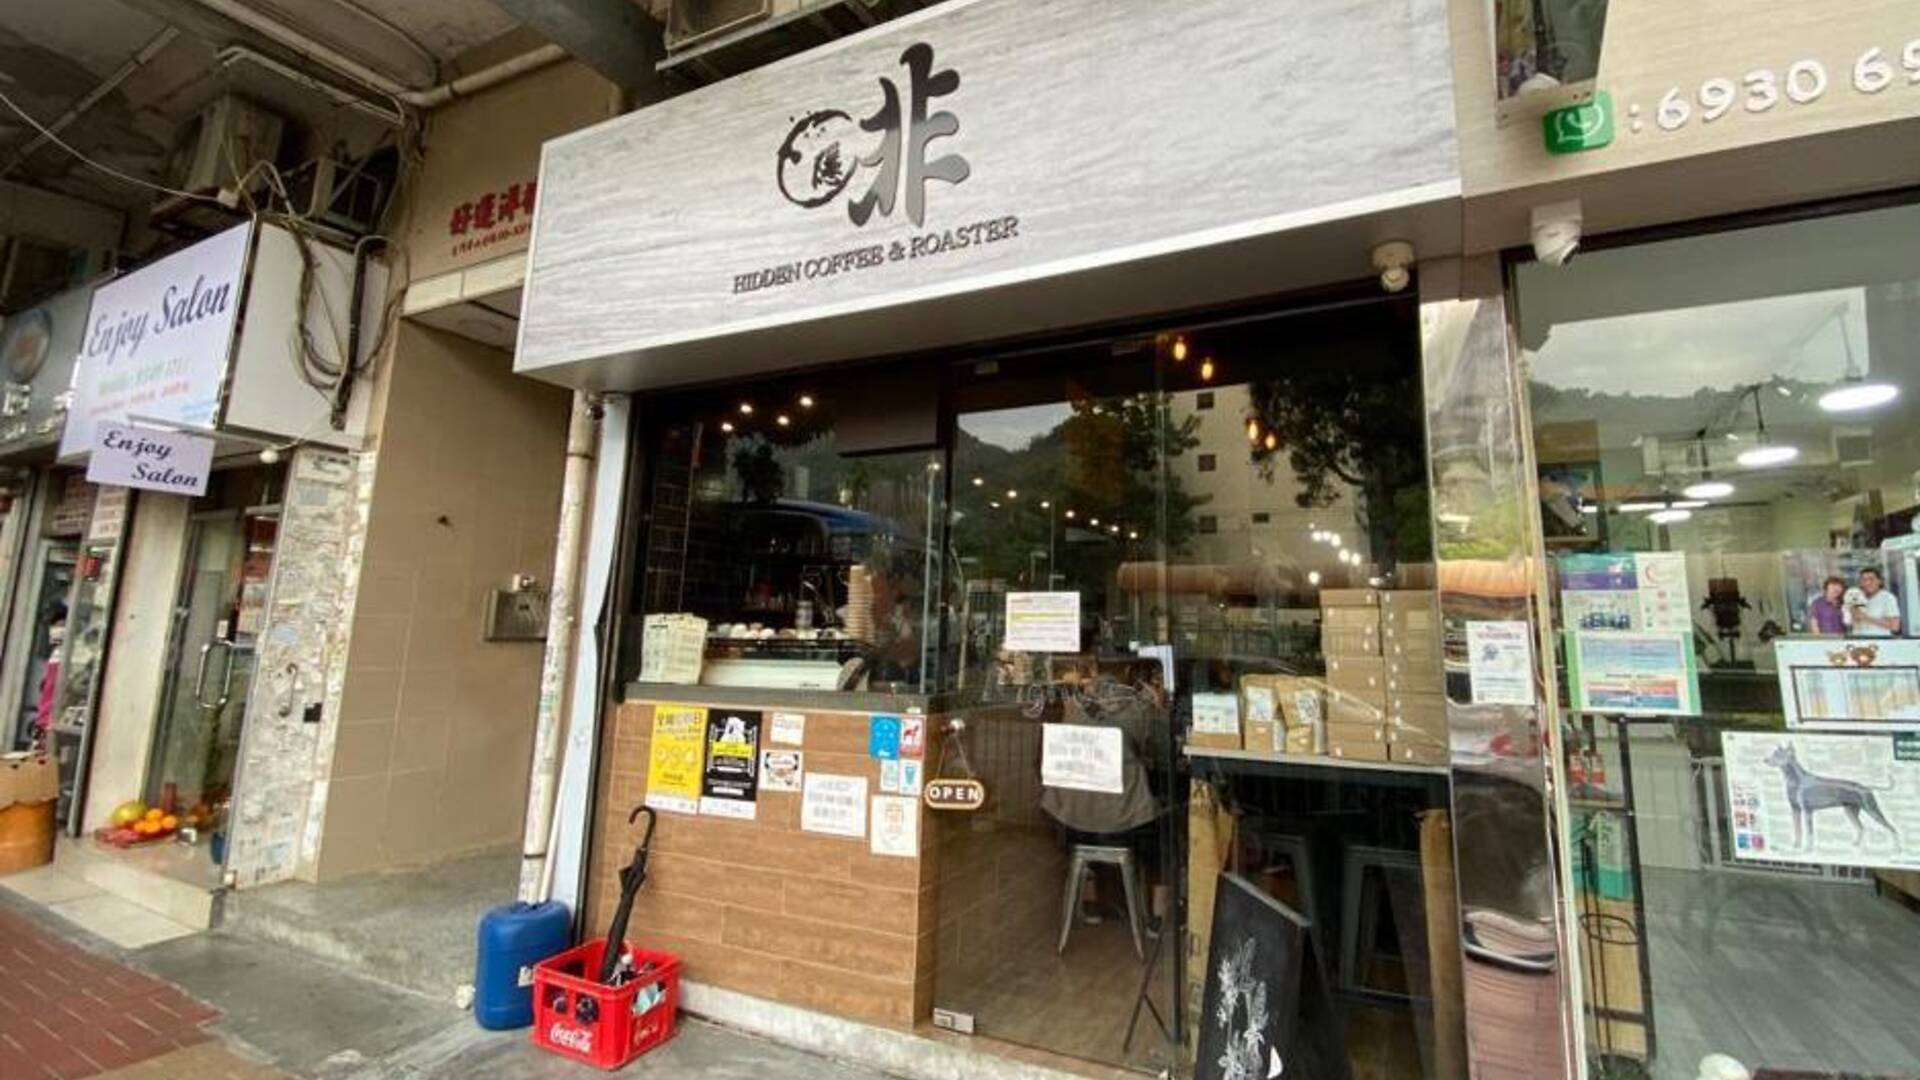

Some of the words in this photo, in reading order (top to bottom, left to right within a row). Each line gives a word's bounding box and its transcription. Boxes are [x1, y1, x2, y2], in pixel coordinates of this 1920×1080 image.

[732, 262, 801, 294] HIDDEN
[803, 244, 884, 280] COFFEE
[888, 240, 905, 262] &
[909, 215, 1020, 258] ROASTER
[88, 305, 149, 365] Enjoy
[153, 274, 231, 334] Salon
[103, 429, 173, 461] Enjoy
[131, 462, 199, 488] Salon
[929, 786, 979, 801] OPEN
